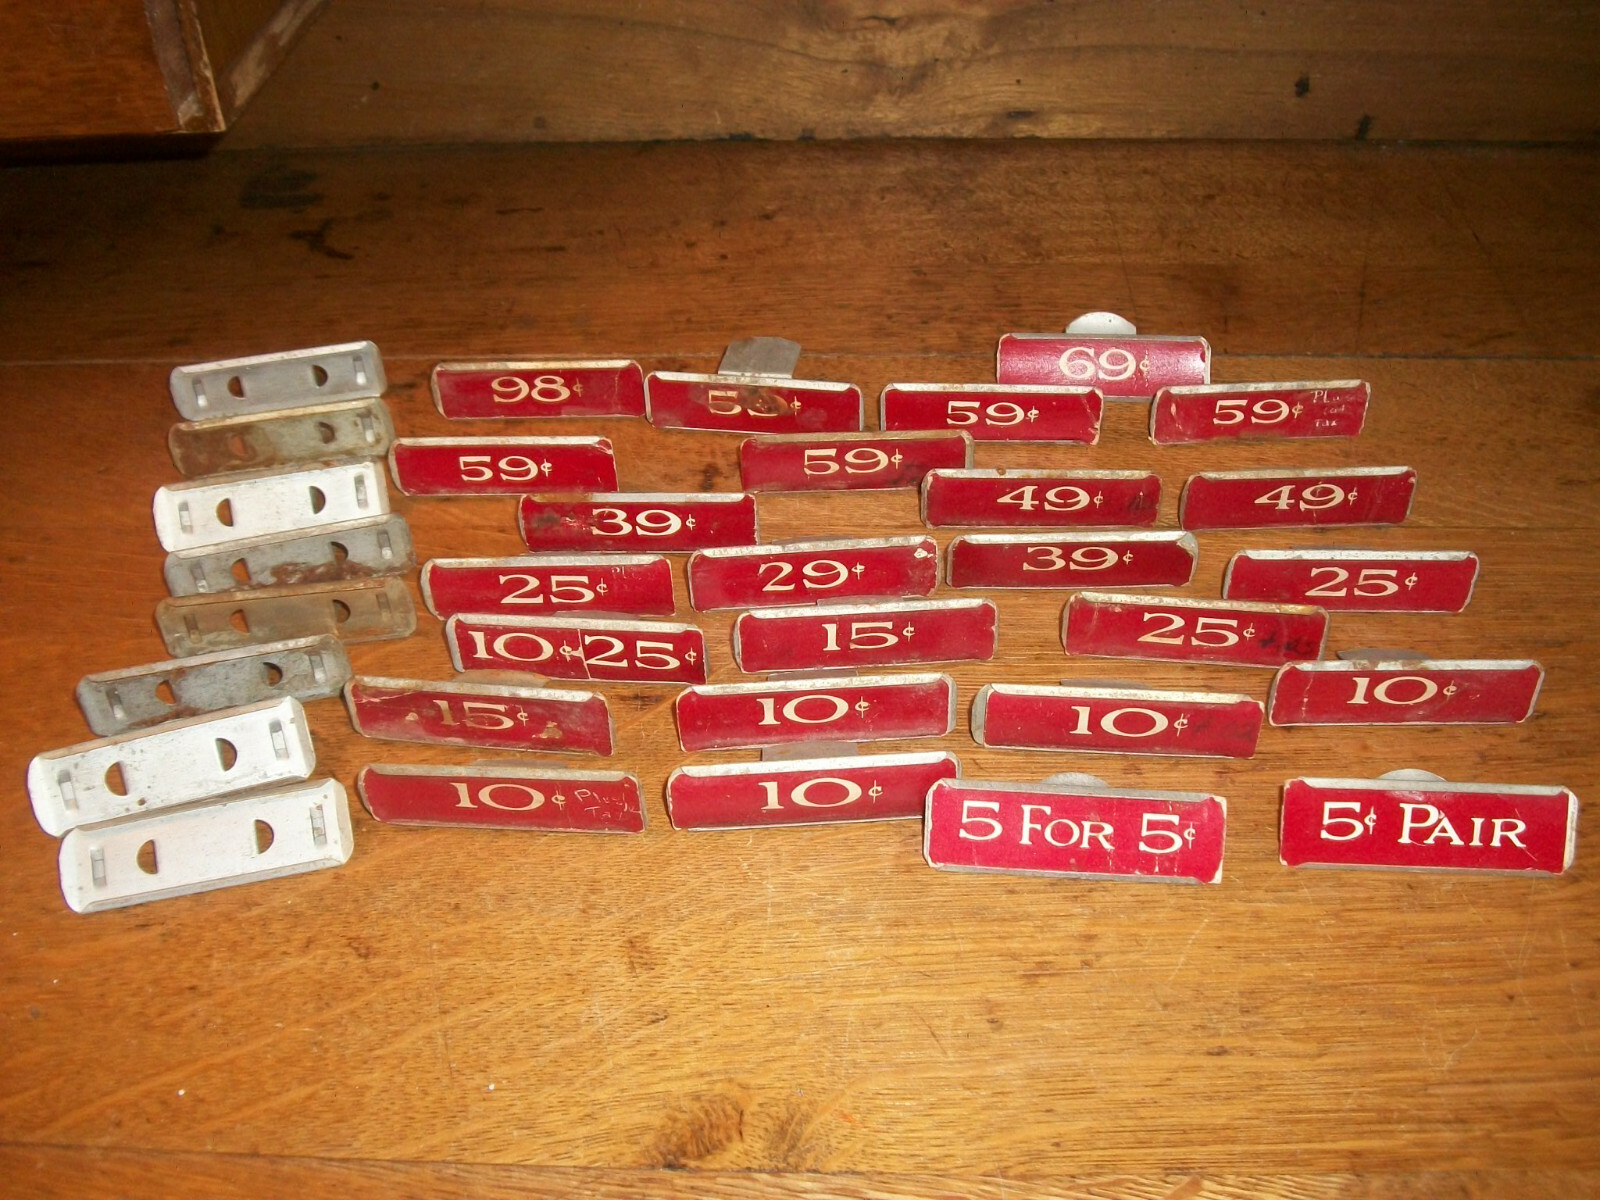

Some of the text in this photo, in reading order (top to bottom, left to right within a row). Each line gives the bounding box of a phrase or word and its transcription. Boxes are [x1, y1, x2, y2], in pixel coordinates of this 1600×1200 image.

[1058, 347, 1151, 380] 69¢
[490, 376, 584, 402] 98¢
[946, 402, 1040, 425] 59¢
[1212, 399, 1303, 424] 59¢
[459, 456, 552, 481] 59¢
[803, 448, 903, 475] 59¢
[997, 485, 1104, 510] 49¢
[1254, 484, 1358, 510] 49¢
[591, 508, 696, 536] 39¢
[1022, 546, 1133, 571] 39¢
[499, 574, 608, 604] 25¢
[758, 560, 865, 592] 29¢
[1304, 567, 1417, 597] 25¢
[822, 621, 915, 651] 15¢
[1137, 612, 1256, 647] 25¢
[1347, 677, 1457, 705] 10¢
[432, 700, 529, 730] 15¢
[756, 695, 870, 726] 10¢
[1068, 705, 1188, 737] 10¢
[450, 782, 566, 811] 10¢
[760, 777, 883, 810] 10¢
[958, 801, 1003, 841] 5
[1138, 813, 1196, 854] 5¢
[1320, 802, 1376, 841] 5¢
